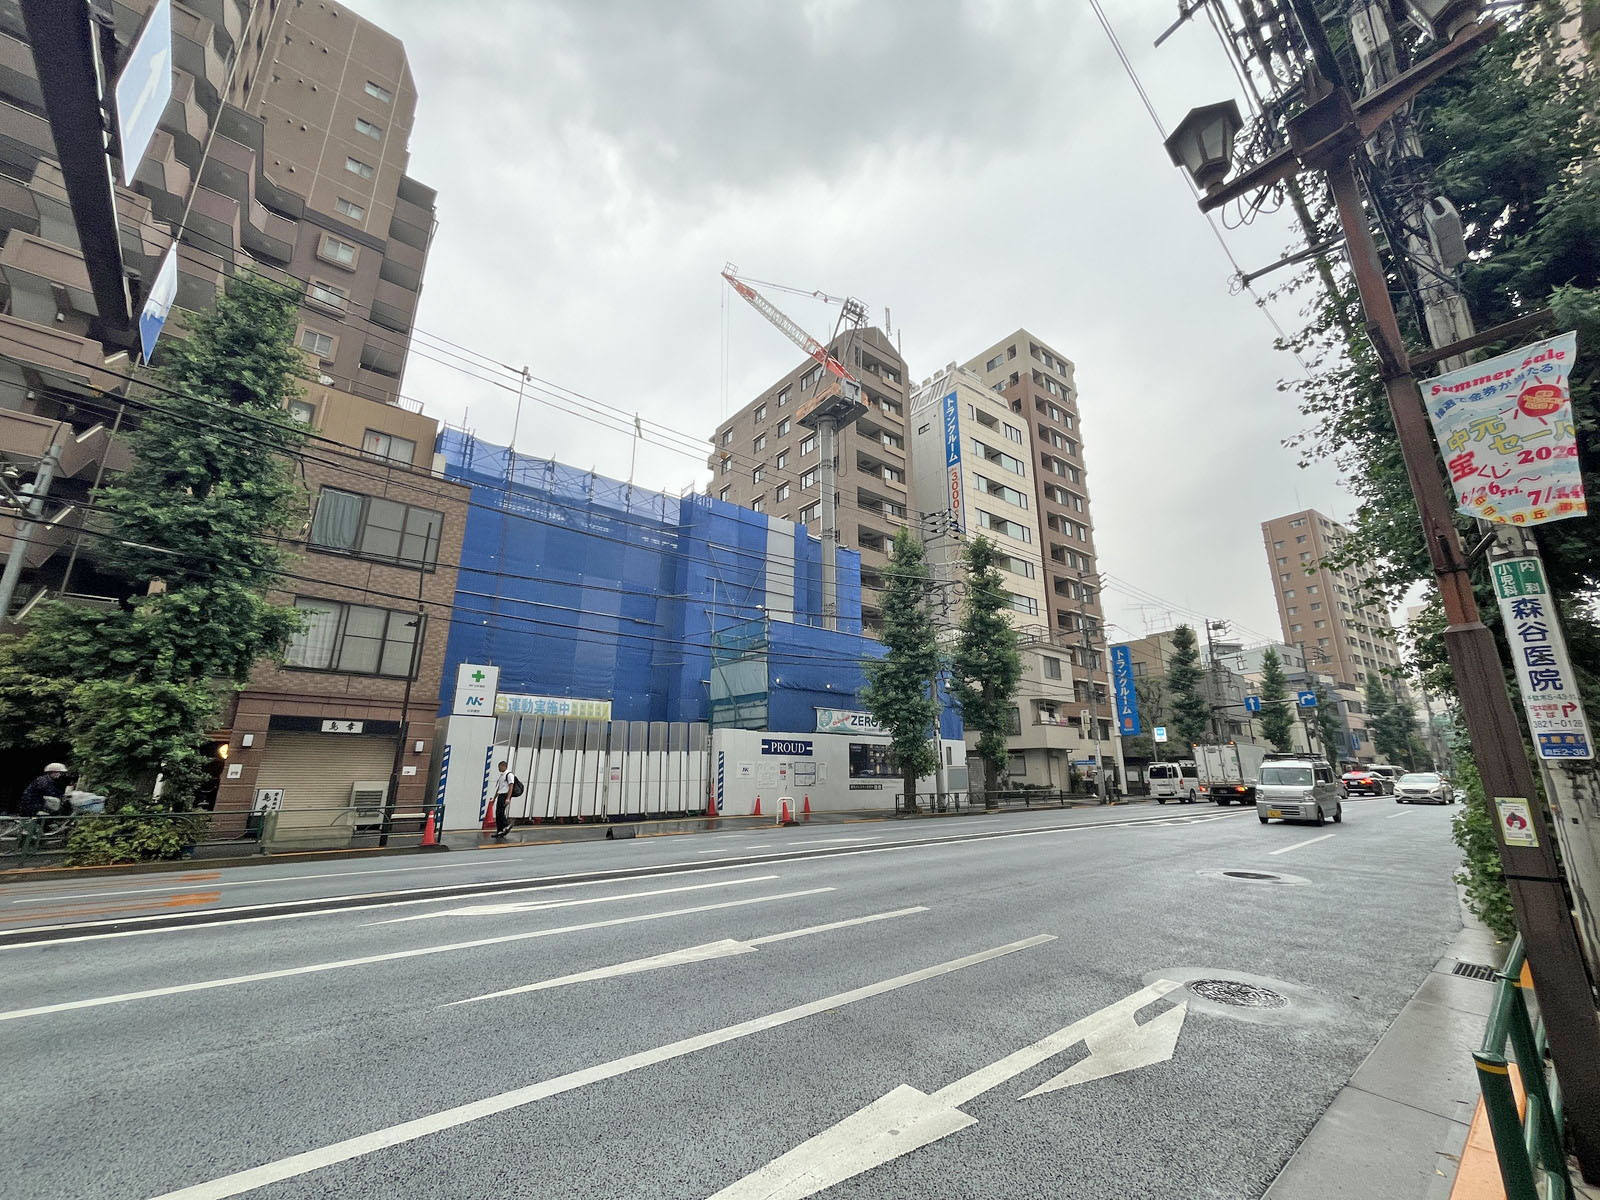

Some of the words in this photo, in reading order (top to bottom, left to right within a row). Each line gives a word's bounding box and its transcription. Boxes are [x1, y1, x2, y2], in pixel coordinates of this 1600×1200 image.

[1431, 367, 1516, 396] Summer
[1521, 348, 1565, 369] sale
[946, 398, 958, 463] トランクルーム
[1448, 450, 1512, 483] 宝くじ
[951, 471, 960, 509] 3000
[1498, 564, 1518, 597] 小児科
[1519, 561, 1541, 594] 内科
[1511, 598, 1564, 692] 森谷医院
[1116, 650, 1132, 715] トランクルーム
[851, 715, 878, 727] ZERO
[771, 742, 805, 754] PROUD
